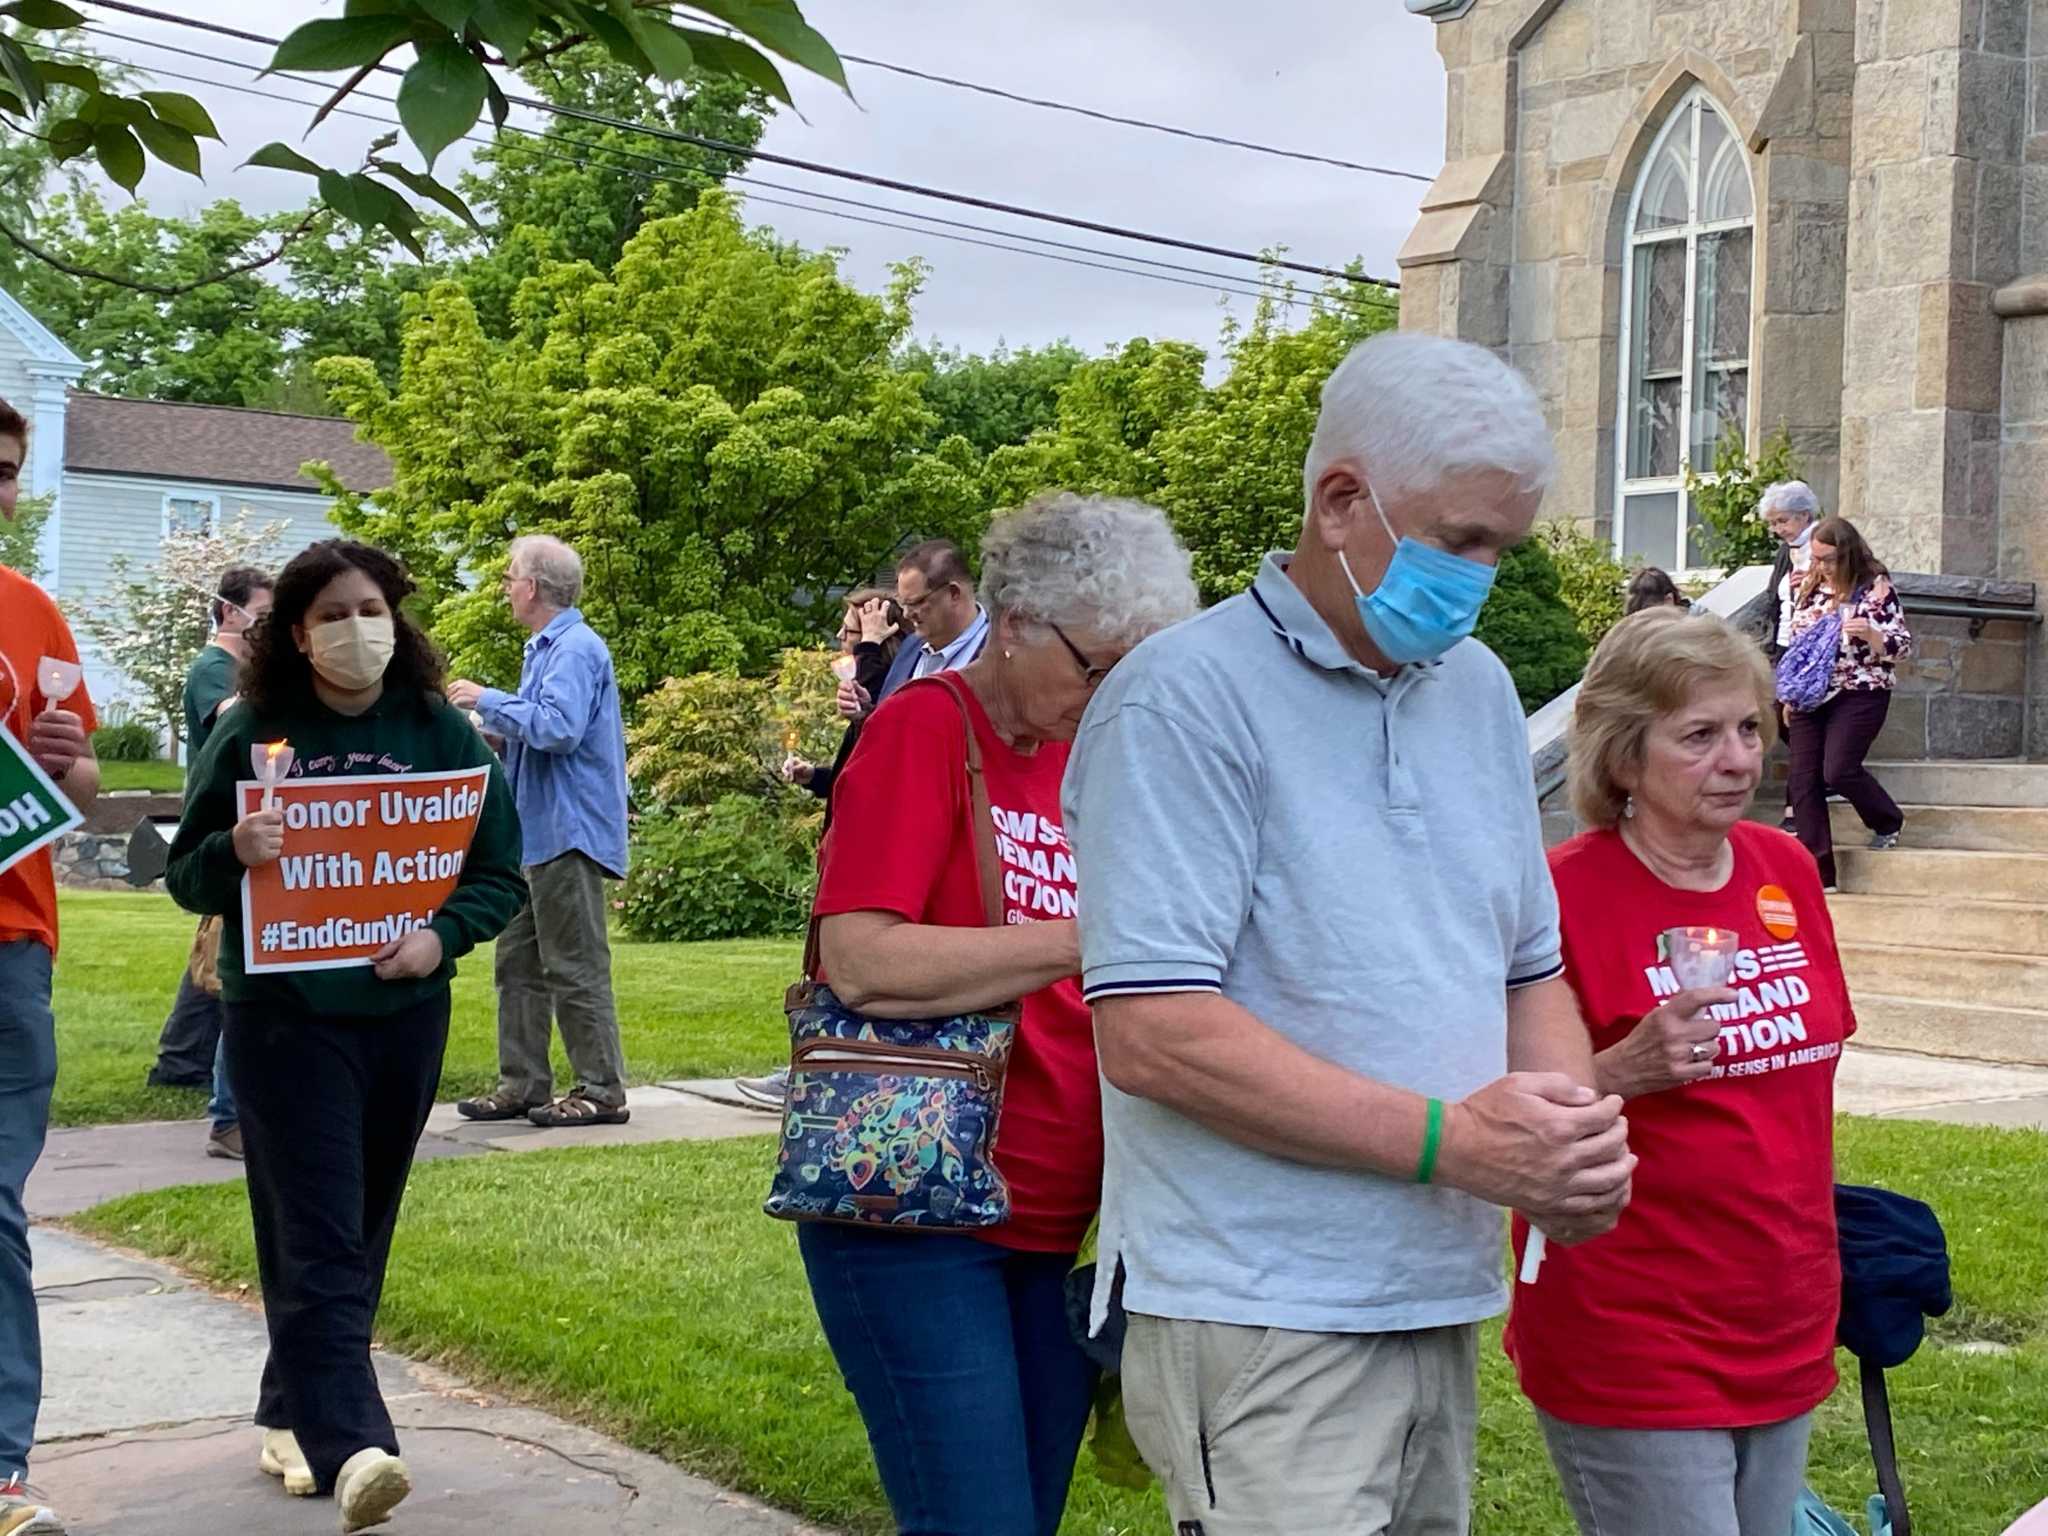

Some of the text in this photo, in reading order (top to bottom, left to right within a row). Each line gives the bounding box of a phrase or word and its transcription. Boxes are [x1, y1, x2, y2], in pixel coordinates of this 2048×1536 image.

[379, 785, 480, 826] Uvalde
[990, 805, 1064, 846] OMS
[279, 847, 464, 890] With Action
[1005, 870, 1078, 918] CTION
[1644, 948, 1762, 997] MS
[1659, 975, 1811, 1021] MAND
[1714, 1011, 1808, 1056] TION
[1728, 1057, 1769, 1078] SENSE
[1771, 1053, 1786, 1071] IN
